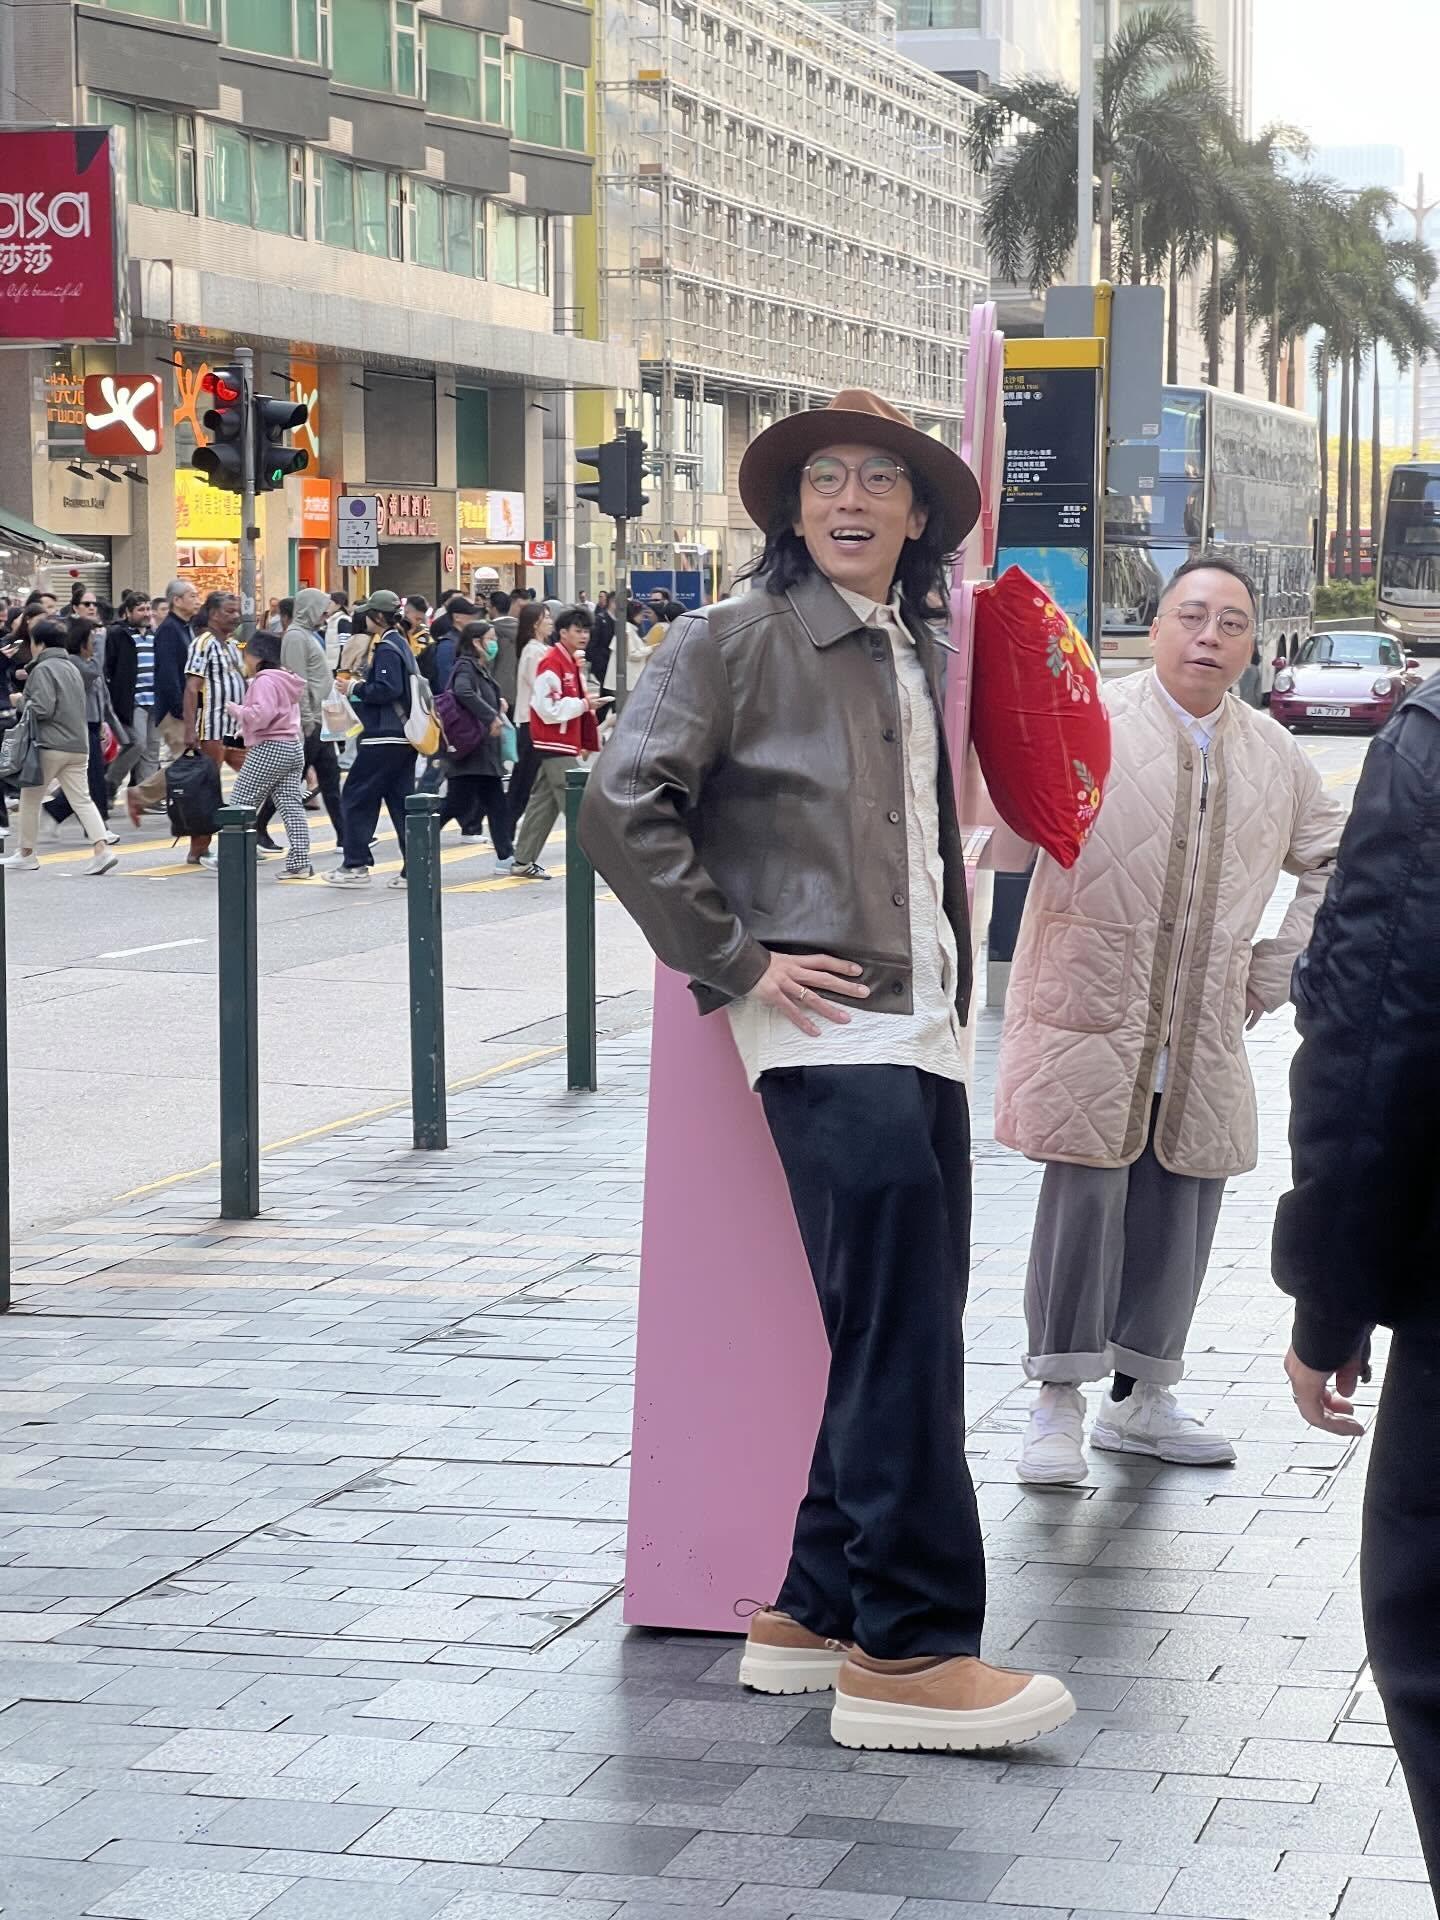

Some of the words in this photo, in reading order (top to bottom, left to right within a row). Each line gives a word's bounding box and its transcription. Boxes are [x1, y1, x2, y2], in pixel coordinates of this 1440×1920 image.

[31, 282, 84, 303] beautiful
[363, 521, 370, 531] 7
[363, 535, 370, 545] 7
[1325, 708, 1346, 716] 7177
